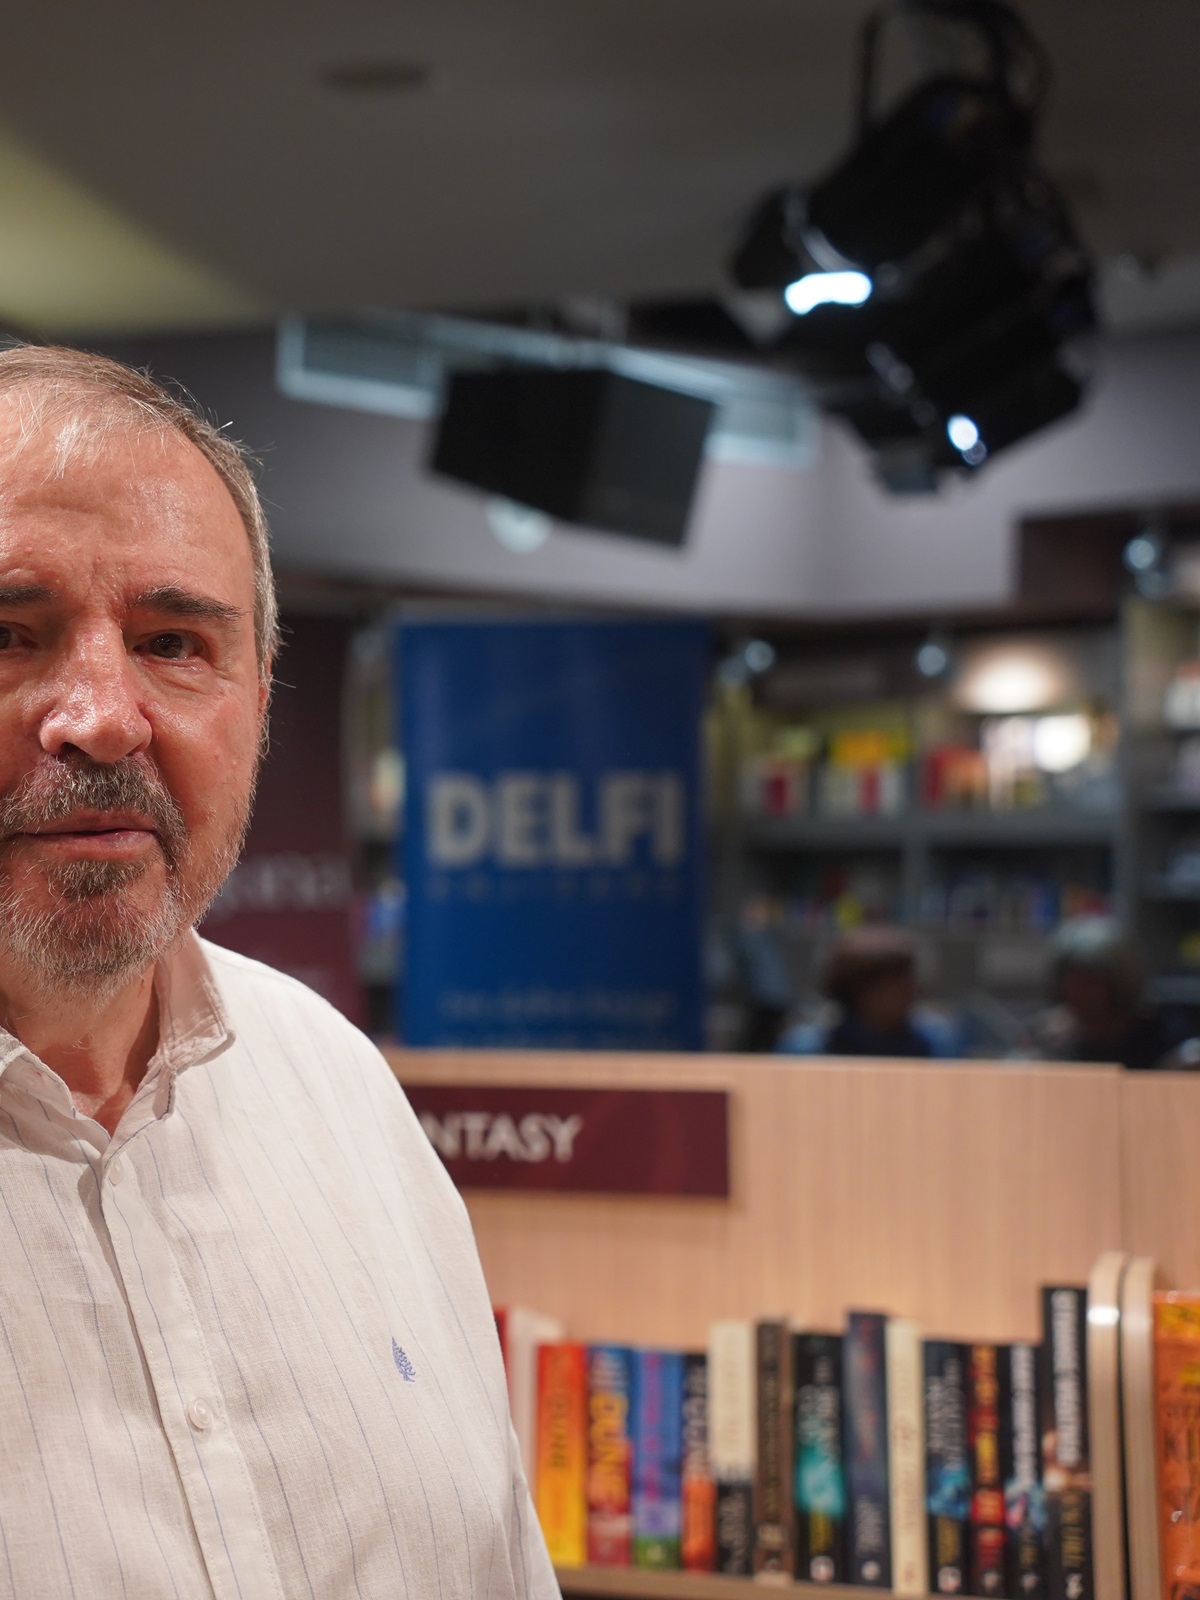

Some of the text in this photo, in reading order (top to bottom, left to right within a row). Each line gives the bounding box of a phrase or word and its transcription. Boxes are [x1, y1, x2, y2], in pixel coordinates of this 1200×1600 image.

[426, 770, 686, 868] DELFI
[418, 1110, 584, 1163] NTASY
[589, 1392, 630, 1506] DUNE
